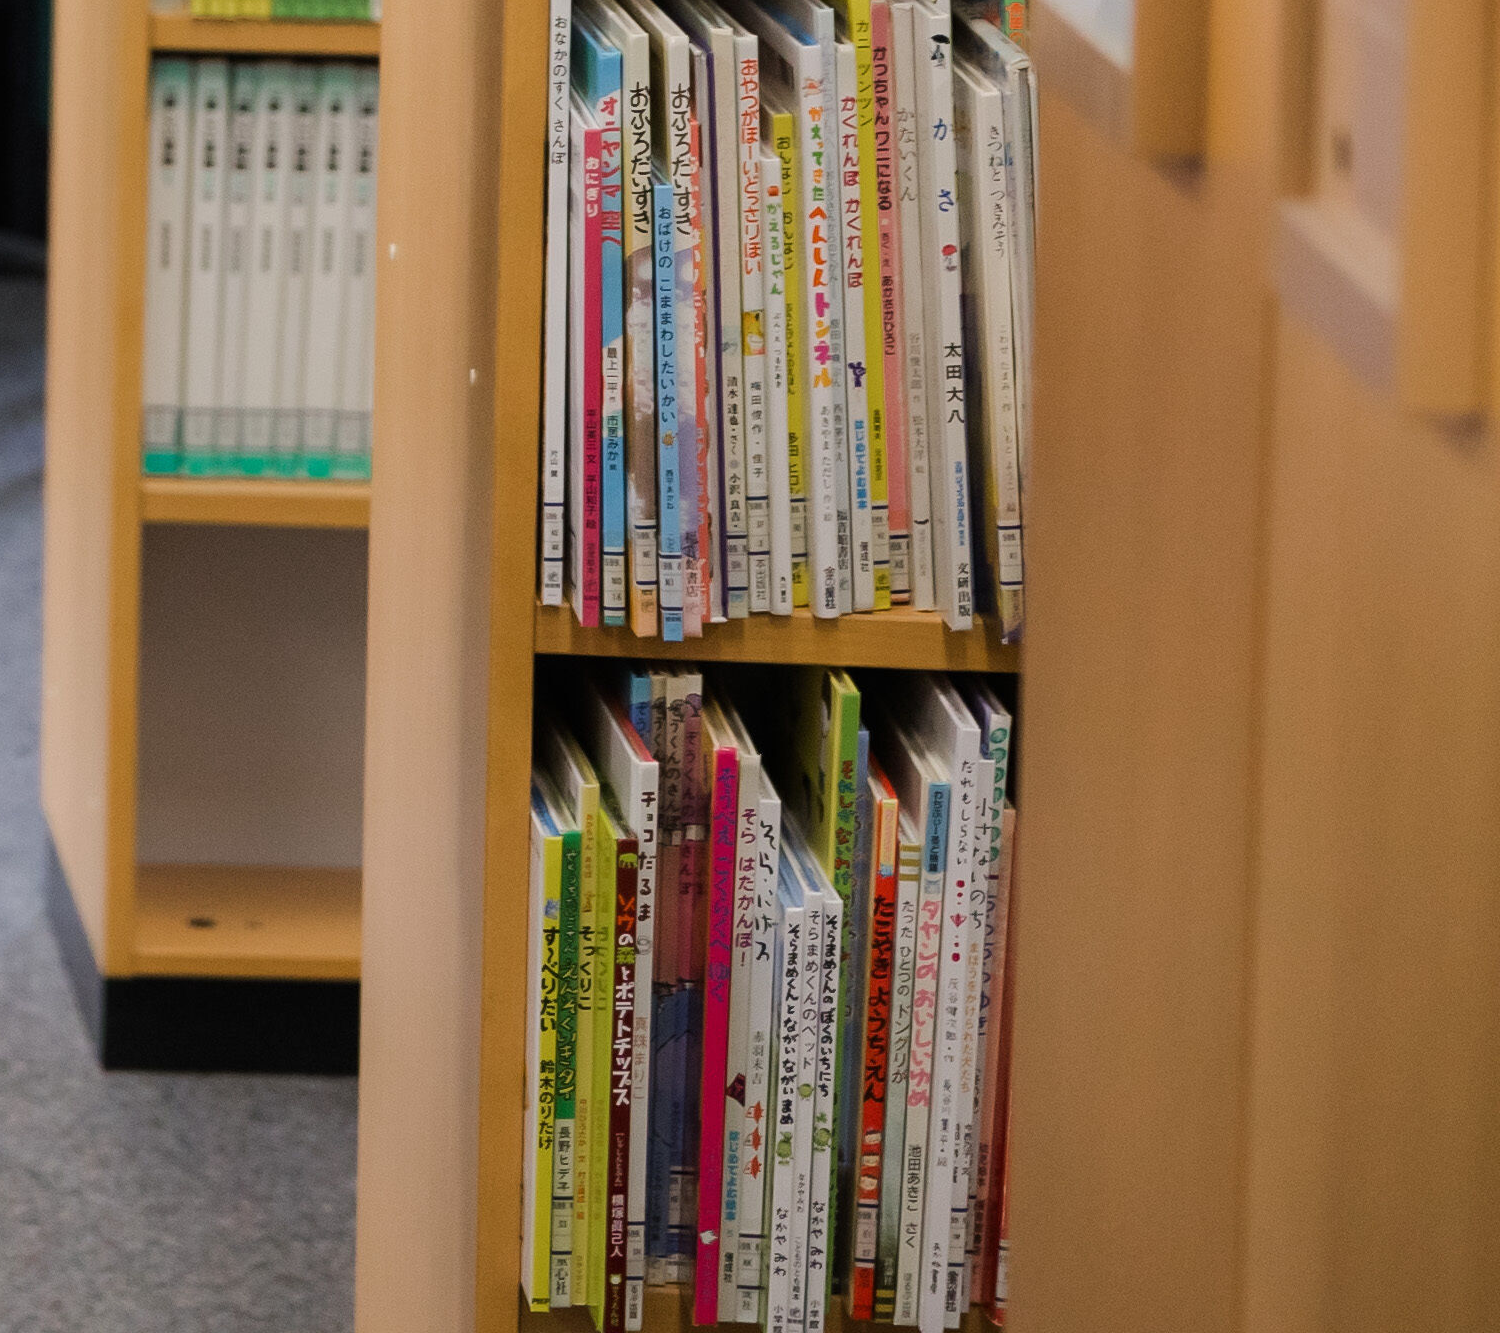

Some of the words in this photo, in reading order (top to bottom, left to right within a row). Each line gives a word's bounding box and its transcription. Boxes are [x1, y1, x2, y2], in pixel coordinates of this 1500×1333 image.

[553, 17, 568, 111] おなかのすく
[856, 21, 870, 48] カニ
[858, 64, 873, 126] ツンツン
[551, 120, 567, 164] さんぽ
[601, 97, 620, 198] オニヤンマ
[630, 82, 650, 233] おふろだいすき
[671, 83, 692, 235] おふろだいすき
[740, 58, 762, 275] おやつがほーいどっさりほい
[841, 97, 859, 186] かくれんぼ
[898, 108, 916, 201] かないくん
[988, 126, 1004, 182] きつねと
[585, 157, 599, 217] おにぎり
[658, 207, 673, 269] おばけの
[846, 199, 863, 288] かくれんぼ
[660, 279, 676, 423] こままわしたいかい
[944, 343, 965, 423] 太田大八
[957, 563, 971, 617] 文研出版
[638, 792, 657, 922] チョコだるま
[740, 808, 757, 844] そら
[957, 761, 976, 865] だれもしらない
[871, 895, 895, 979] たこやき
[900, 901, 914, 938] たった
[578, 926, 595, 1011] そっくりこ
[612, 894, 636, 1106] ゾウの森とポテトチップス
[802, 910, 821, 1069] そらまめくんのベッド
[818, 914, 838, 1097] そらまめくんのぼくのいちにち
[897, 946, 912, 997] ひとつの
[864, 987, 890, 1103] ようちえん
[892, 1005, 911, 1084] ドングリが
[907, 989, 935, 1107] おいしいゆめ
[539, 1060, 555, 1150] 鈴木のりたけ
[557, 1126, 571, 1191] 長野ヒデ子
